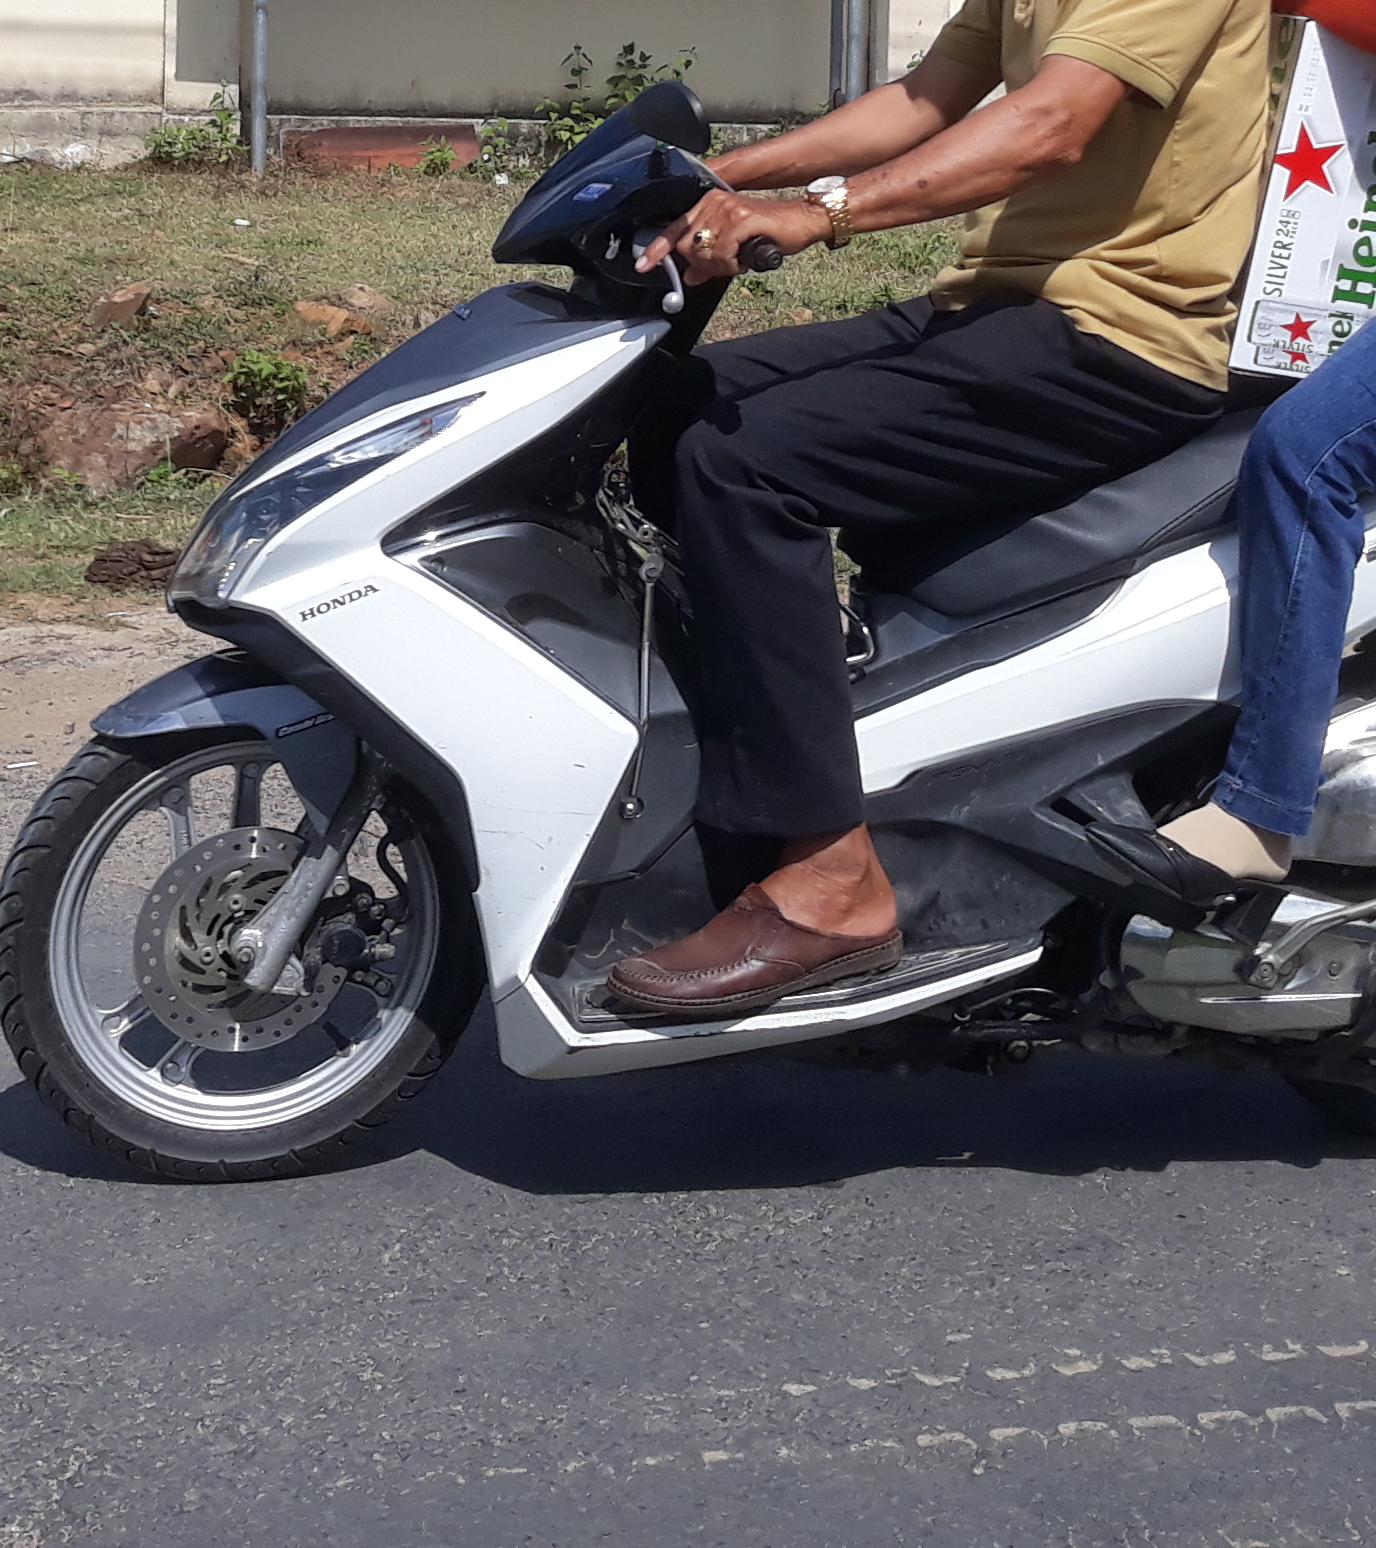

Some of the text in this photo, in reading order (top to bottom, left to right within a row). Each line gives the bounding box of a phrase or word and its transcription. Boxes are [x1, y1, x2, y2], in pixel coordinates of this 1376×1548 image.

[1276, 219, 1292, 238] 24
[1262, 240, 1295, 298] SILVER
[298, 584, 381, 623] HONDA
